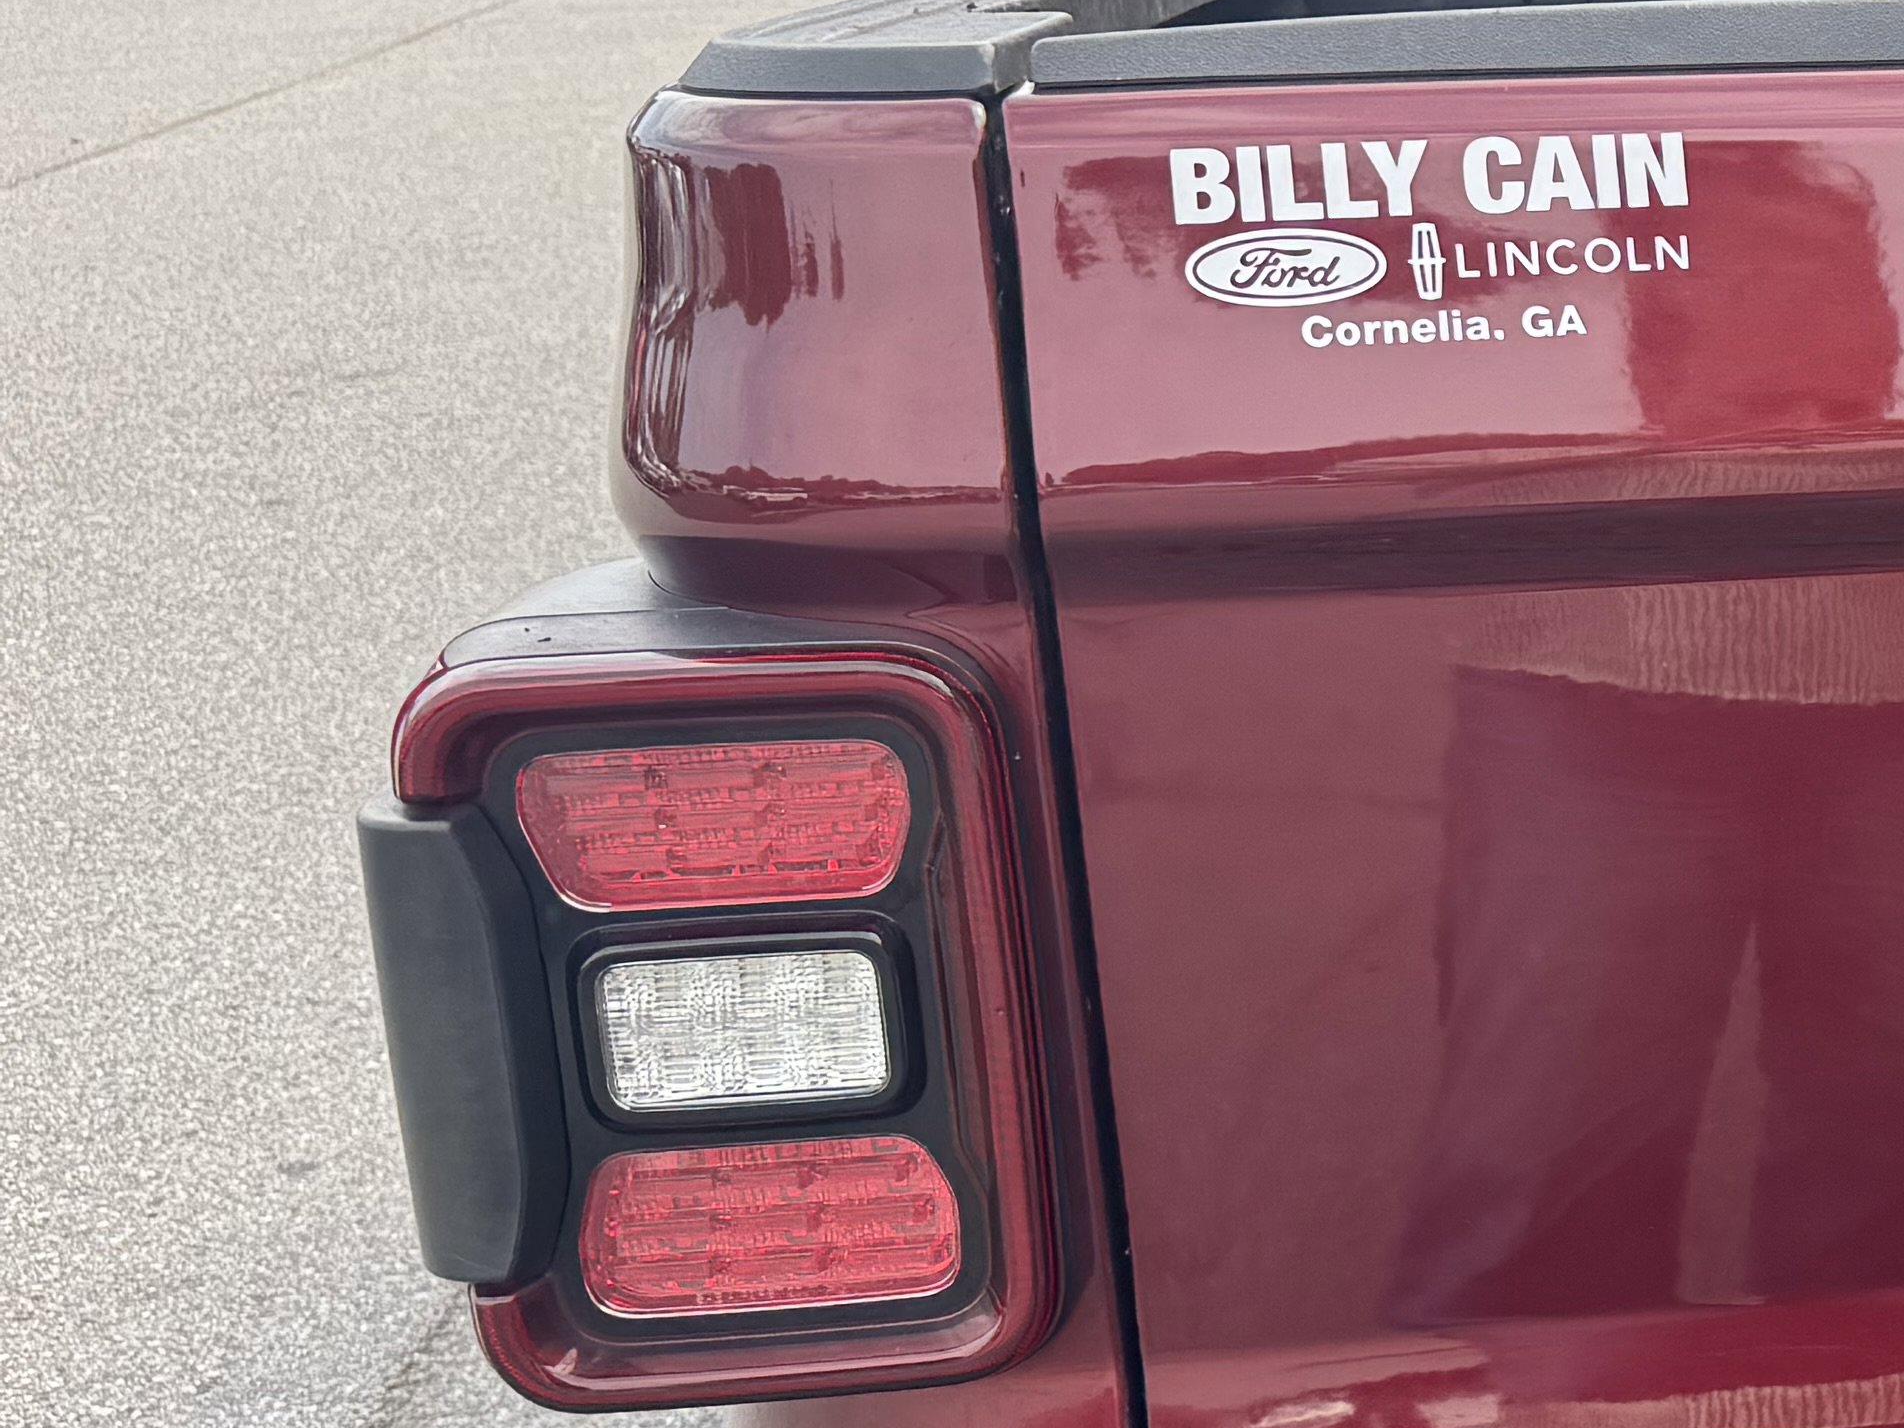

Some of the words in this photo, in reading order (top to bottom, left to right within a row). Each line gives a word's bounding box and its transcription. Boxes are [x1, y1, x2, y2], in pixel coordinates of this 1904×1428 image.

[1169, 139, 1428, 225] BILLY
[1463, 131, 1689, 214] CAIN
[1229, 247, 1342, 290] Ford
[1454, 234, 1690, 279] LINCOLN
[1521, 304, 1587, 338] GA
